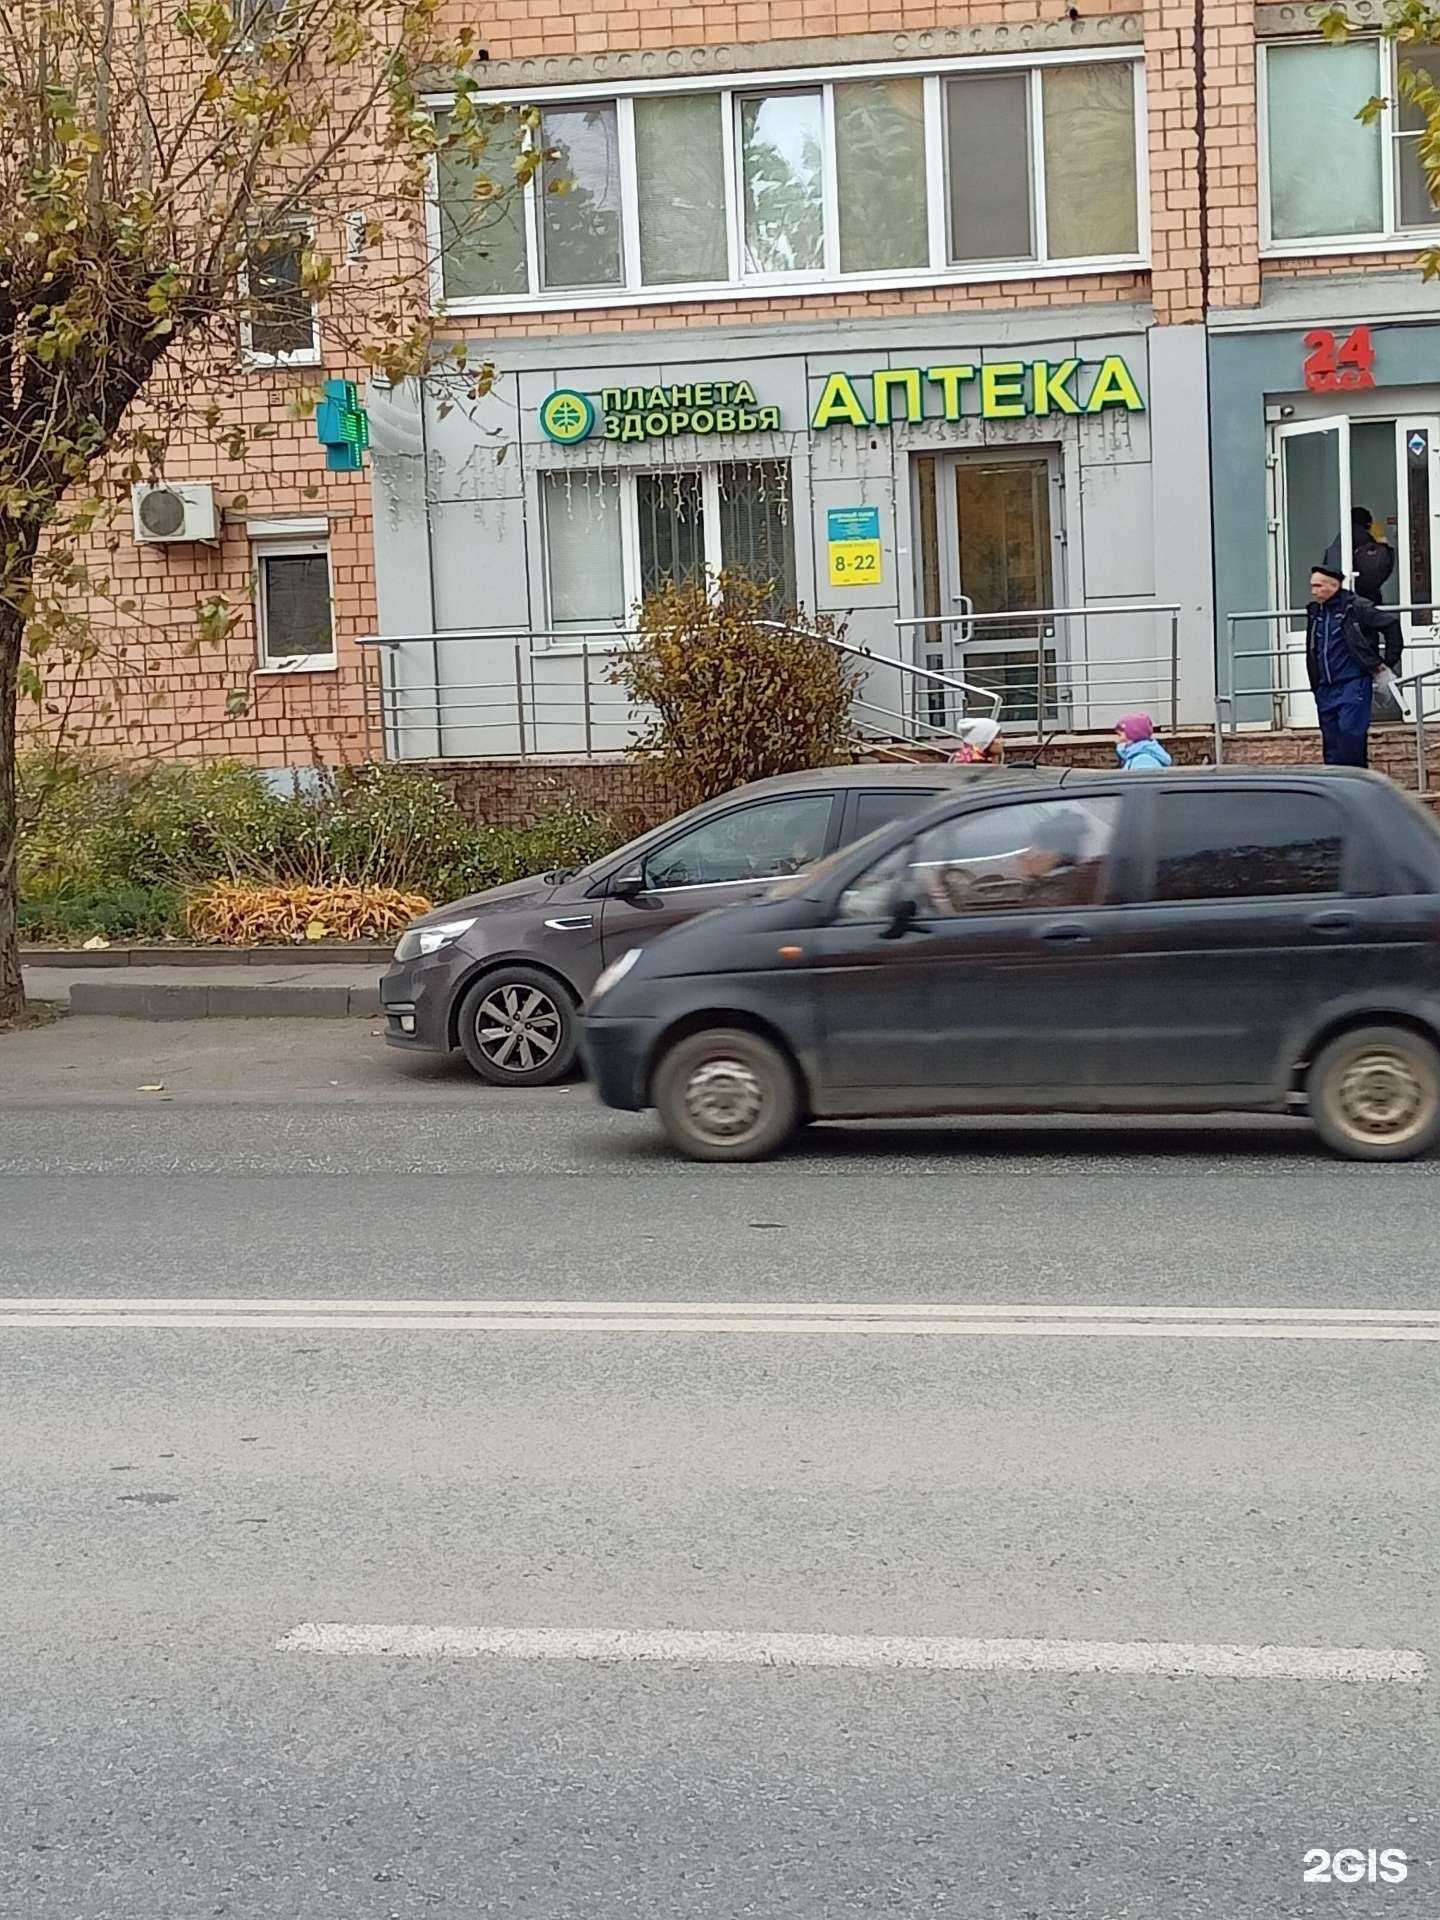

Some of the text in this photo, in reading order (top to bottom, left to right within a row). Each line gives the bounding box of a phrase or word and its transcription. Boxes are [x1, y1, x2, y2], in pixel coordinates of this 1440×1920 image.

[1303, 326, 1376, 373] 24
[601, 380, 757, 411] ПЛАНЕТА
[811, 355, 1145, 429] АПТЕКА
[603, 406, 780, 442] ЗДОРОВЬЯ
